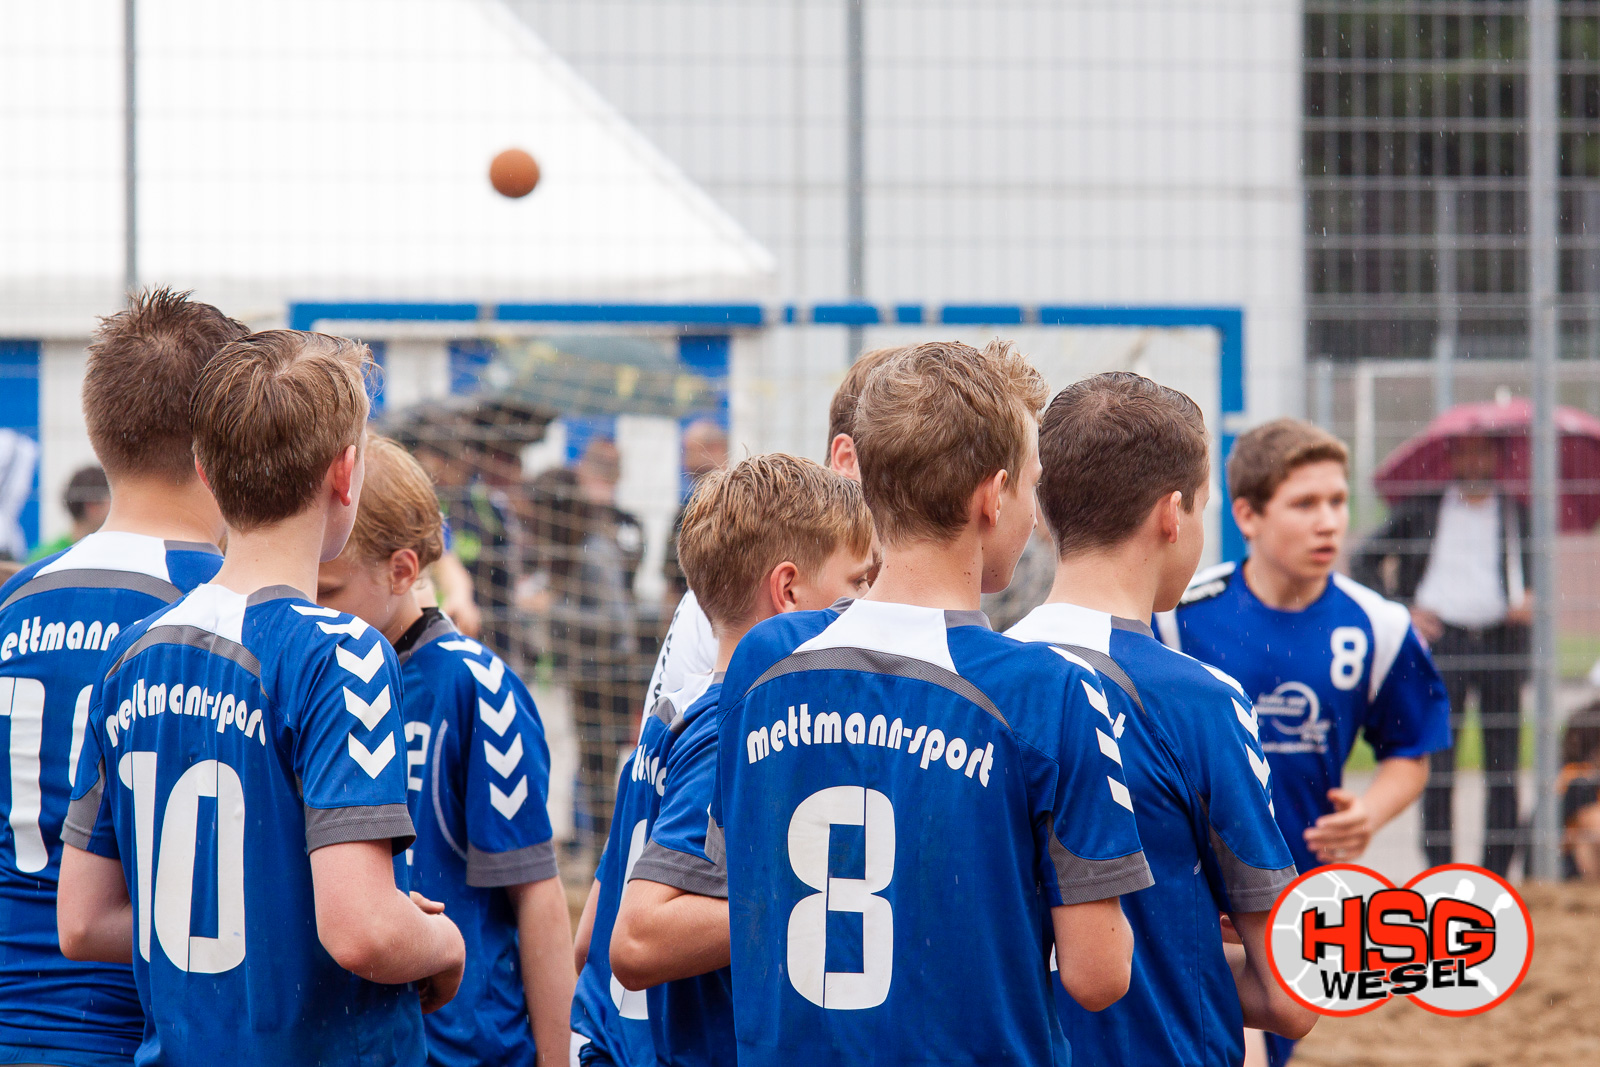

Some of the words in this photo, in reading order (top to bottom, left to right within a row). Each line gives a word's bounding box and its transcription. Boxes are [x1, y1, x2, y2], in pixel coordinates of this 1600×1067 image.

[1330, 626, 1368, 691] 8
[747, 703, 994, 788] mettmann-sport
[118, 751, 246, 974] 10
[787, 785, 896, 1010] 8
